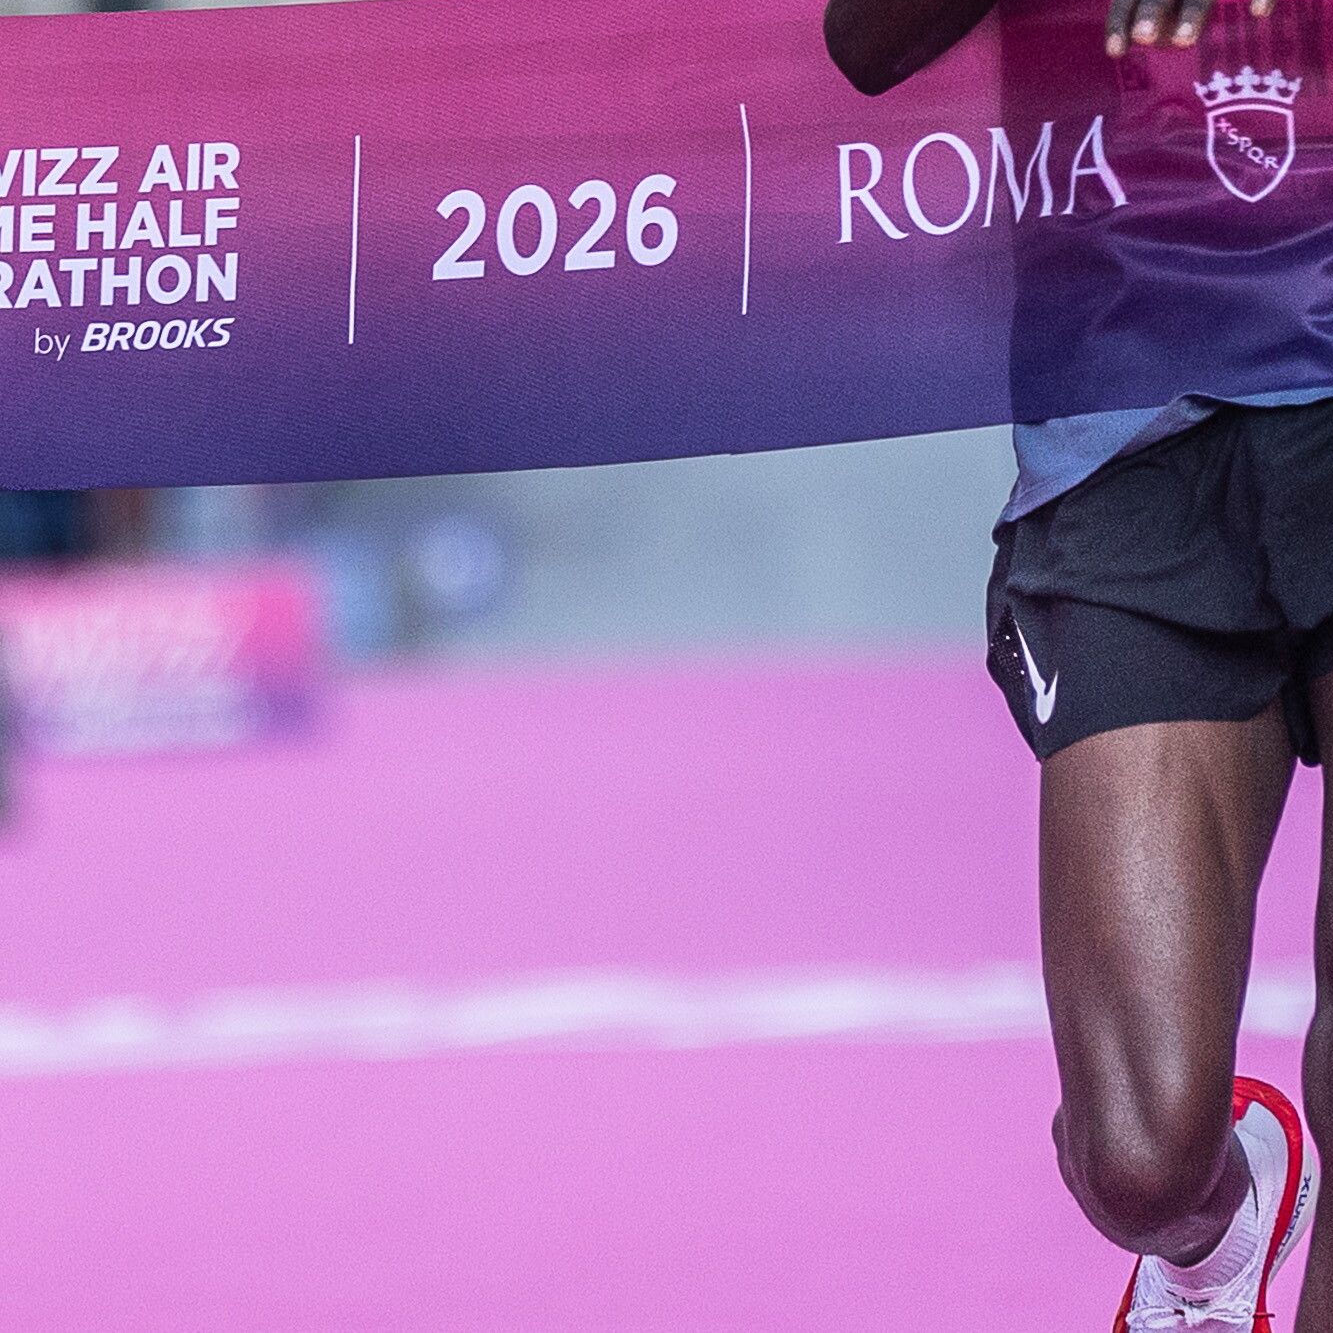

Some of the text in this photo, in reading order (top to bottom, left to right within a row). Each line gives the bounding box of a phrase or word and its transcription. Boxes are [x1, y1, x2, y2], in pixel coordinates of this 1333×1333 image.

[137, 142, 241, 193] AIR
[836, 114, 1130, 245] ROMA
[75, 197, 240, 251] HALF
[432, 174, 679, 281] 2026
[34, 317, 236, 362] by BROOKS
